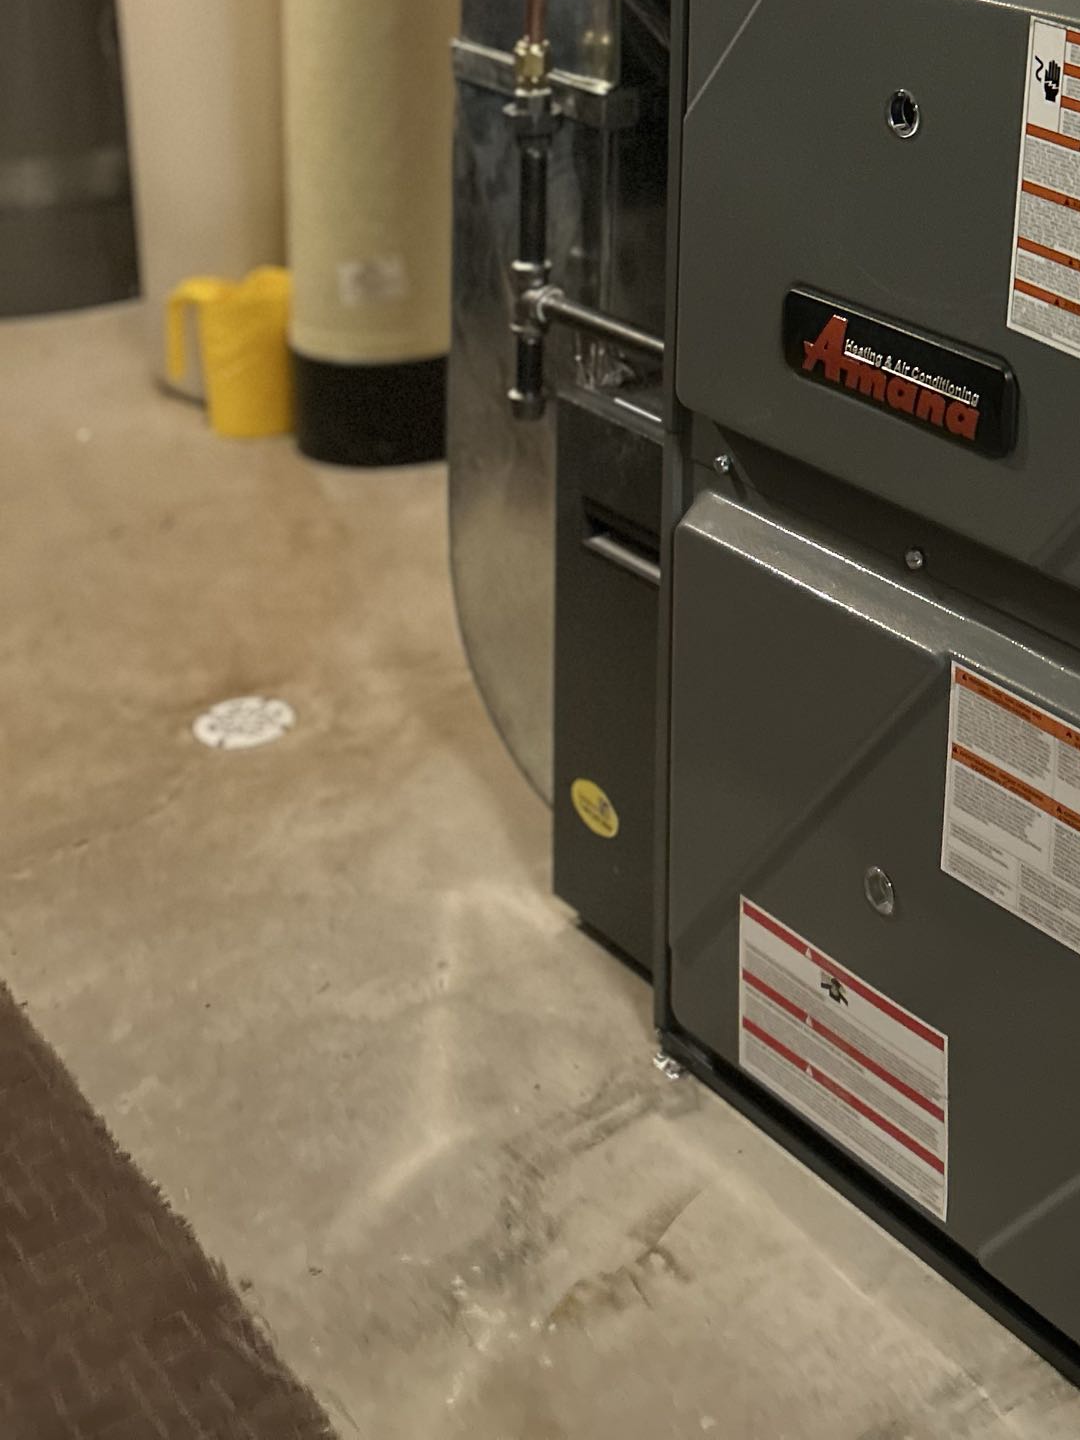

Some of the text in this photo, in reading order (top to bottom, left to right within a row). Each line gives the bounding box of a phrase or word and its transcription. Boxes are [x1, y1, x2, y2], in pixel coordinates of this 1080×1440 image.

[802, 314, 981, 442] Amana
[844, 337, 980, 407] Heating & Air Conditioning
